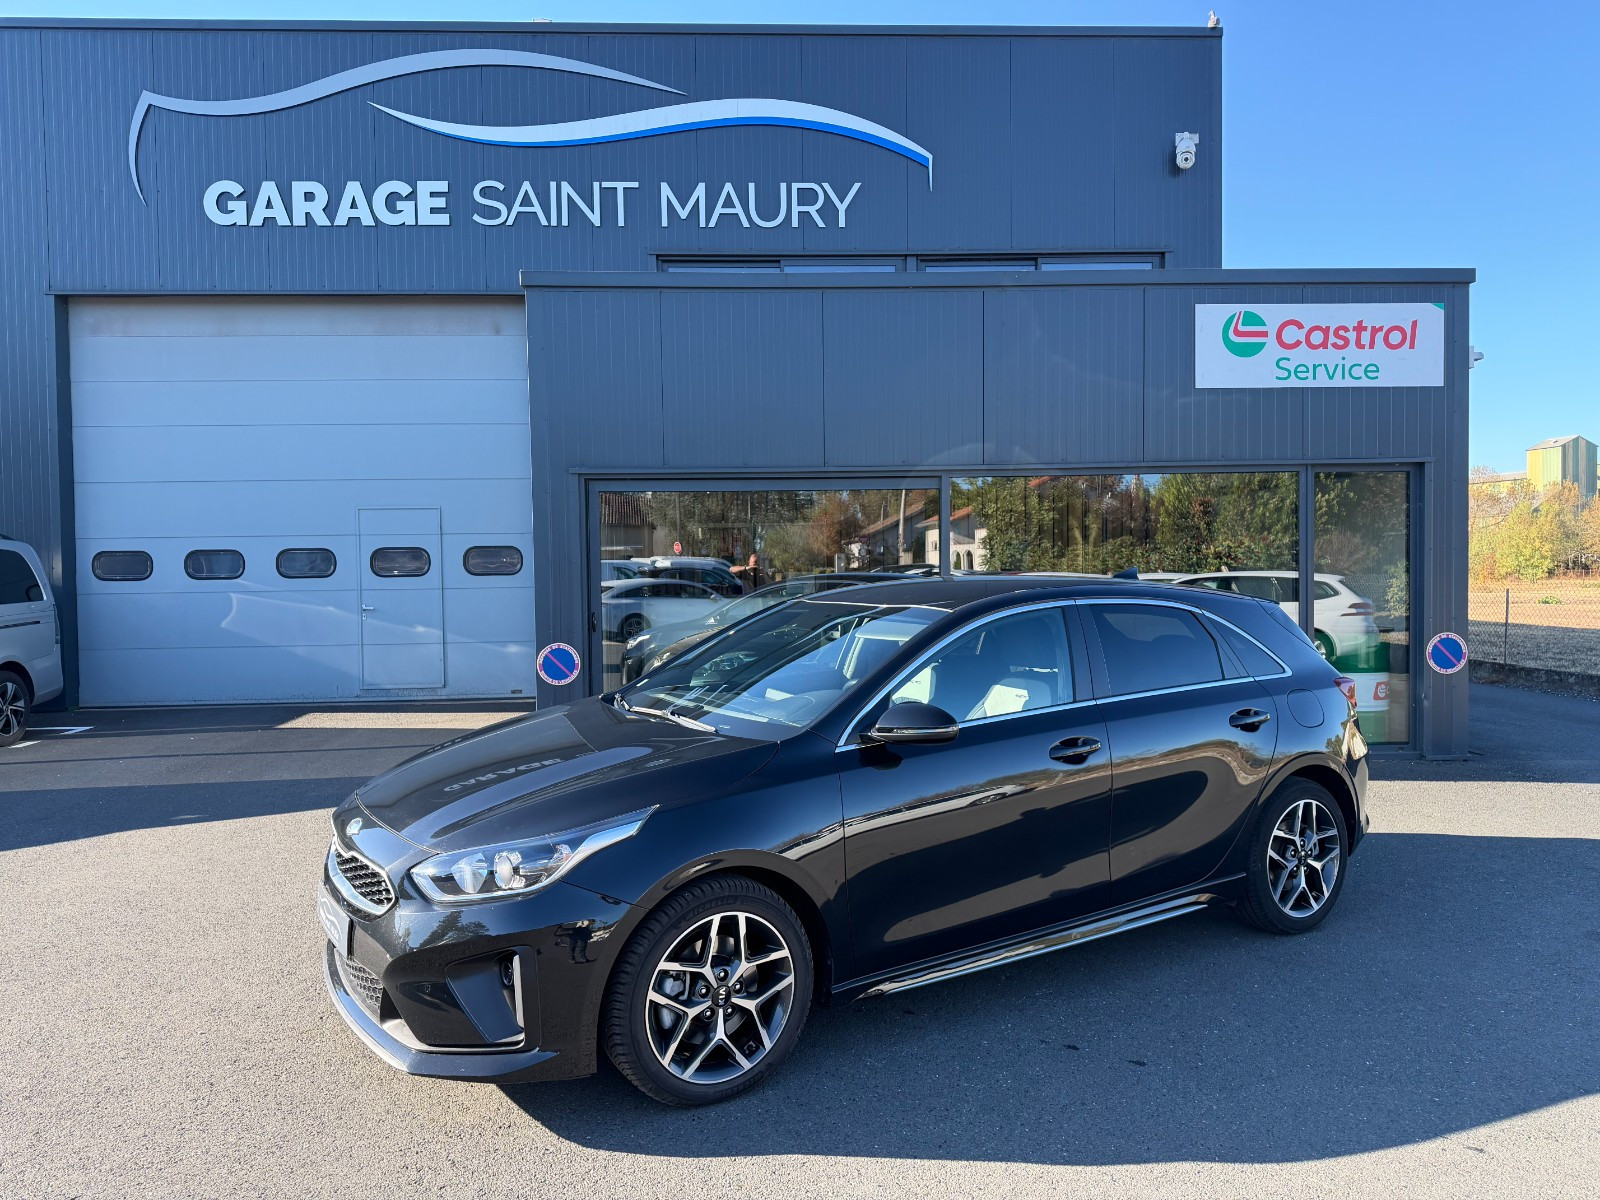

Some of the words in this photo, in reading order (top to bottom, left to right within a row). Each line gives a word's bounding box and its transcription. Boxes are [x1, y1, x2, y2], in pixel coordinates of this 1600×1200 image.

[203, 179, 450, 226] GARAGE
[472, 180, 639, 227] SAINT
[660, 182, 862, 228] MAURY
[1275, 319, 1418, 350] Castrol
[1275, 356, 1380, 380] Service
